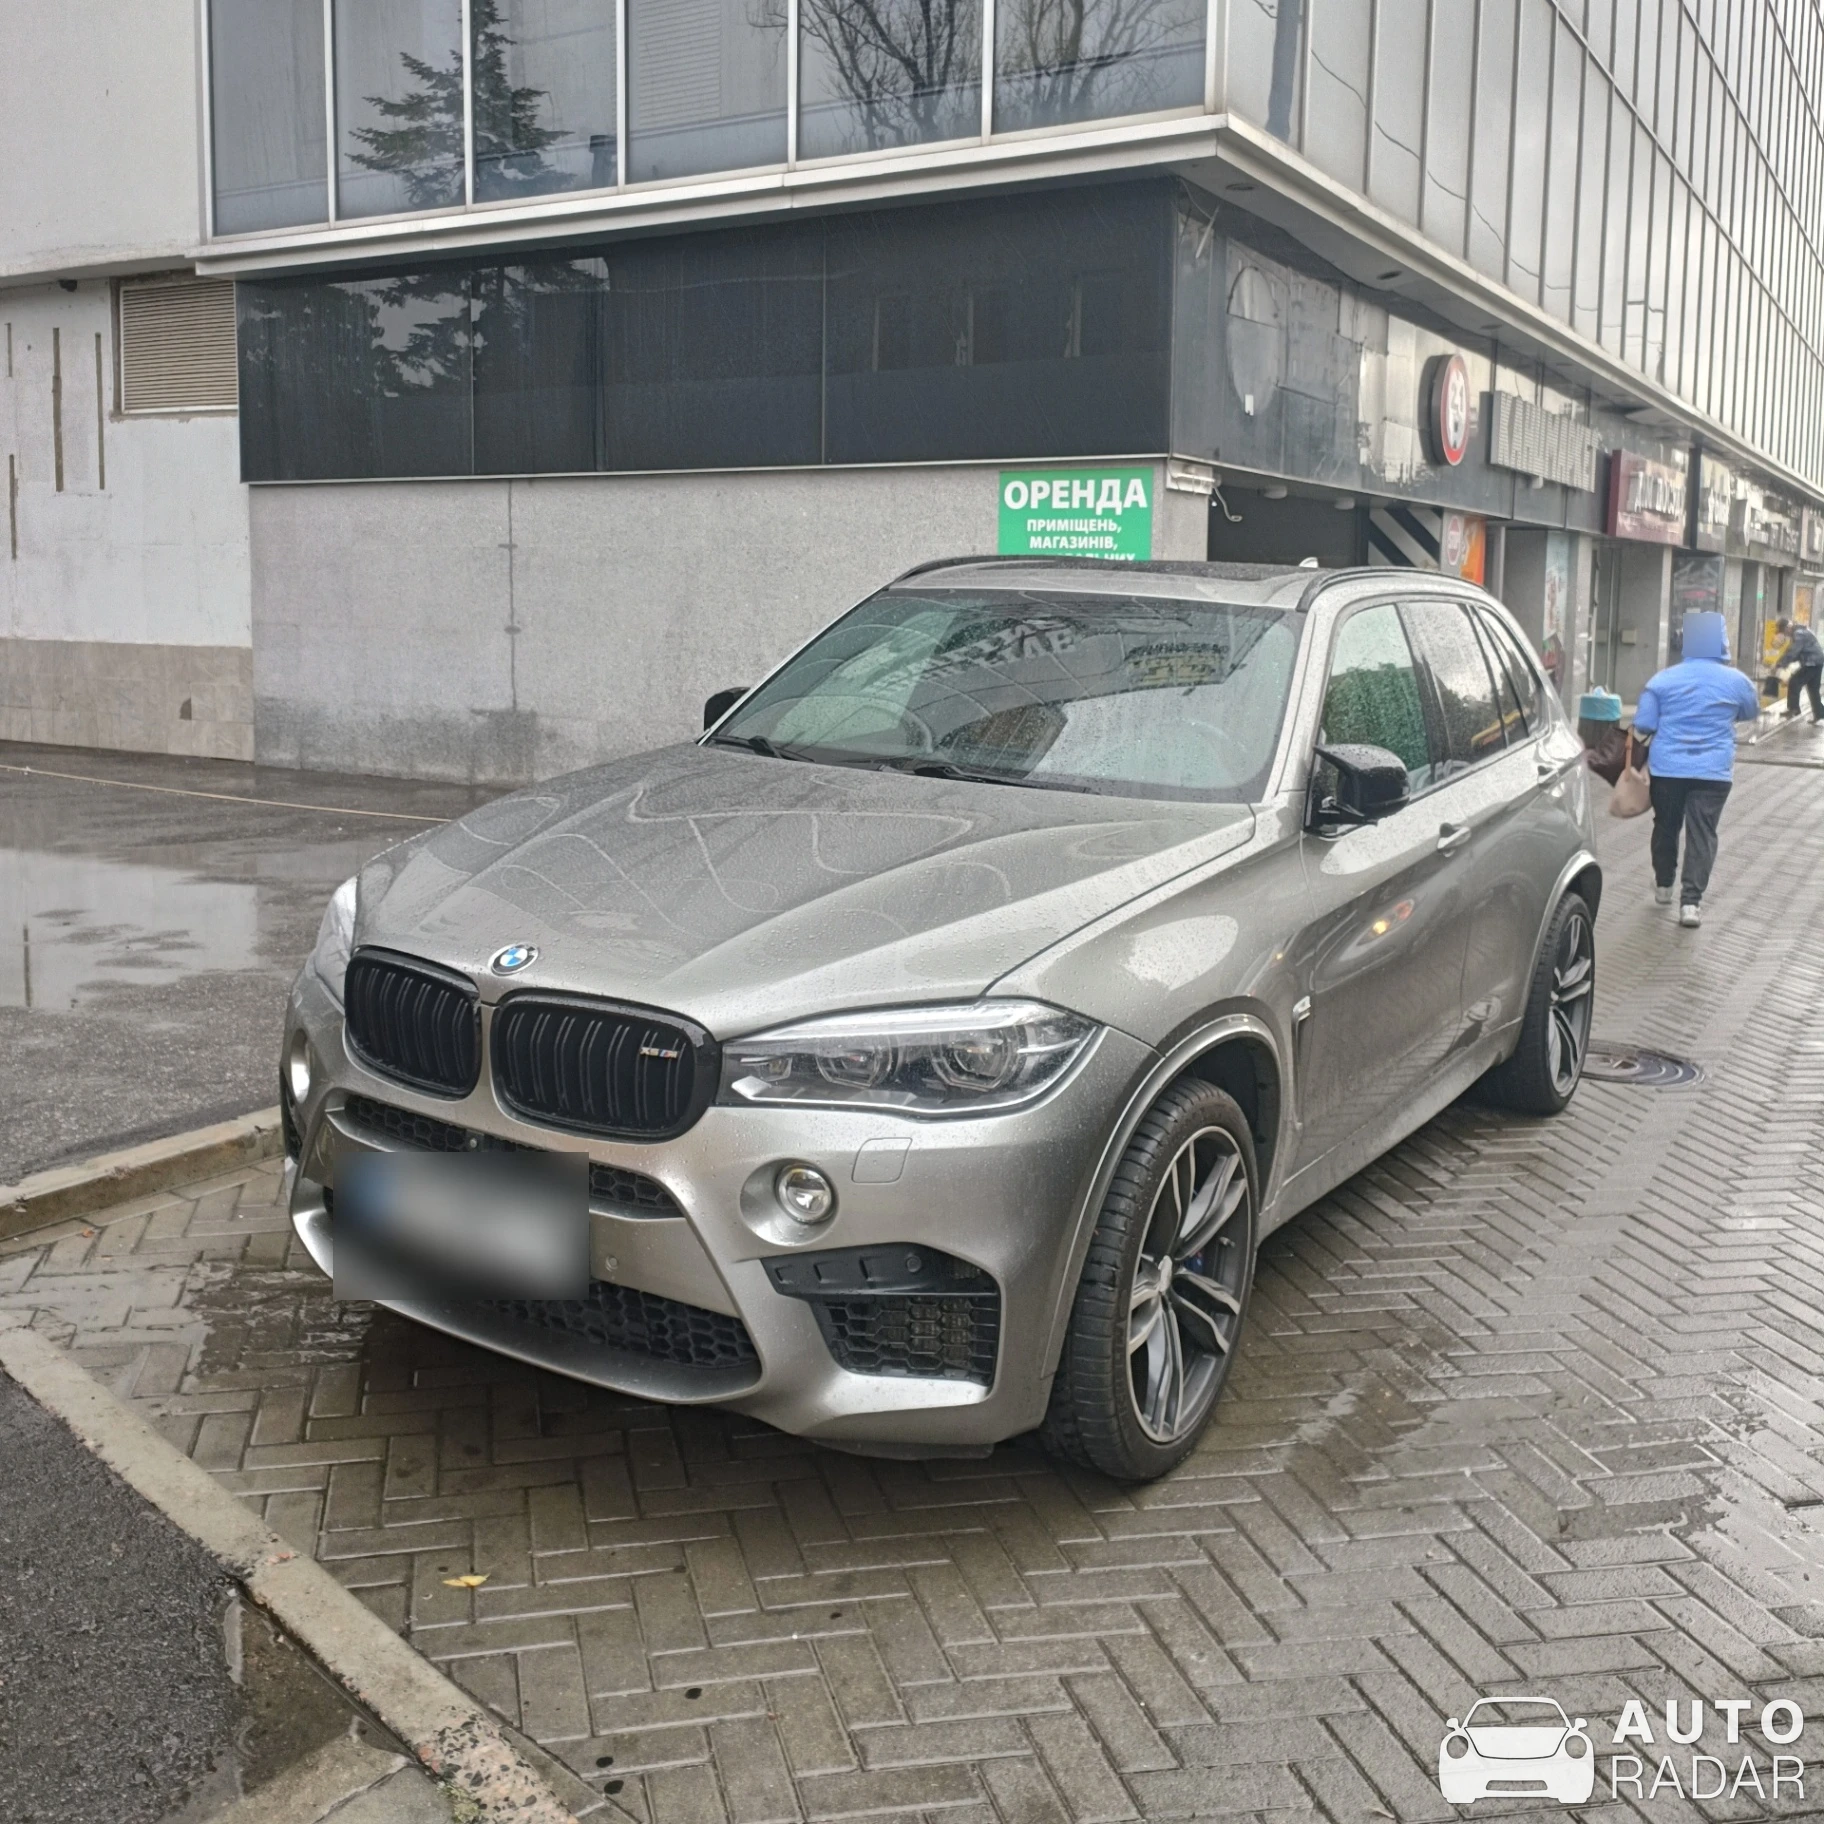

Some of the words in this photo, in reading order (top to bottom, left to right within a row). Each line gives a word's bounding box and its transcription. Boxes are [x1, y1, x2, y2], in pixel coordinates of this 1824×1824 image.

[1003, 478, 1148, 516] ОРЕНДА
[1026, 518, 1122, 534] ПРИМІЩЕНЬ,
[1029, 536, 1118, 551] МАГАЗИНІВ,
